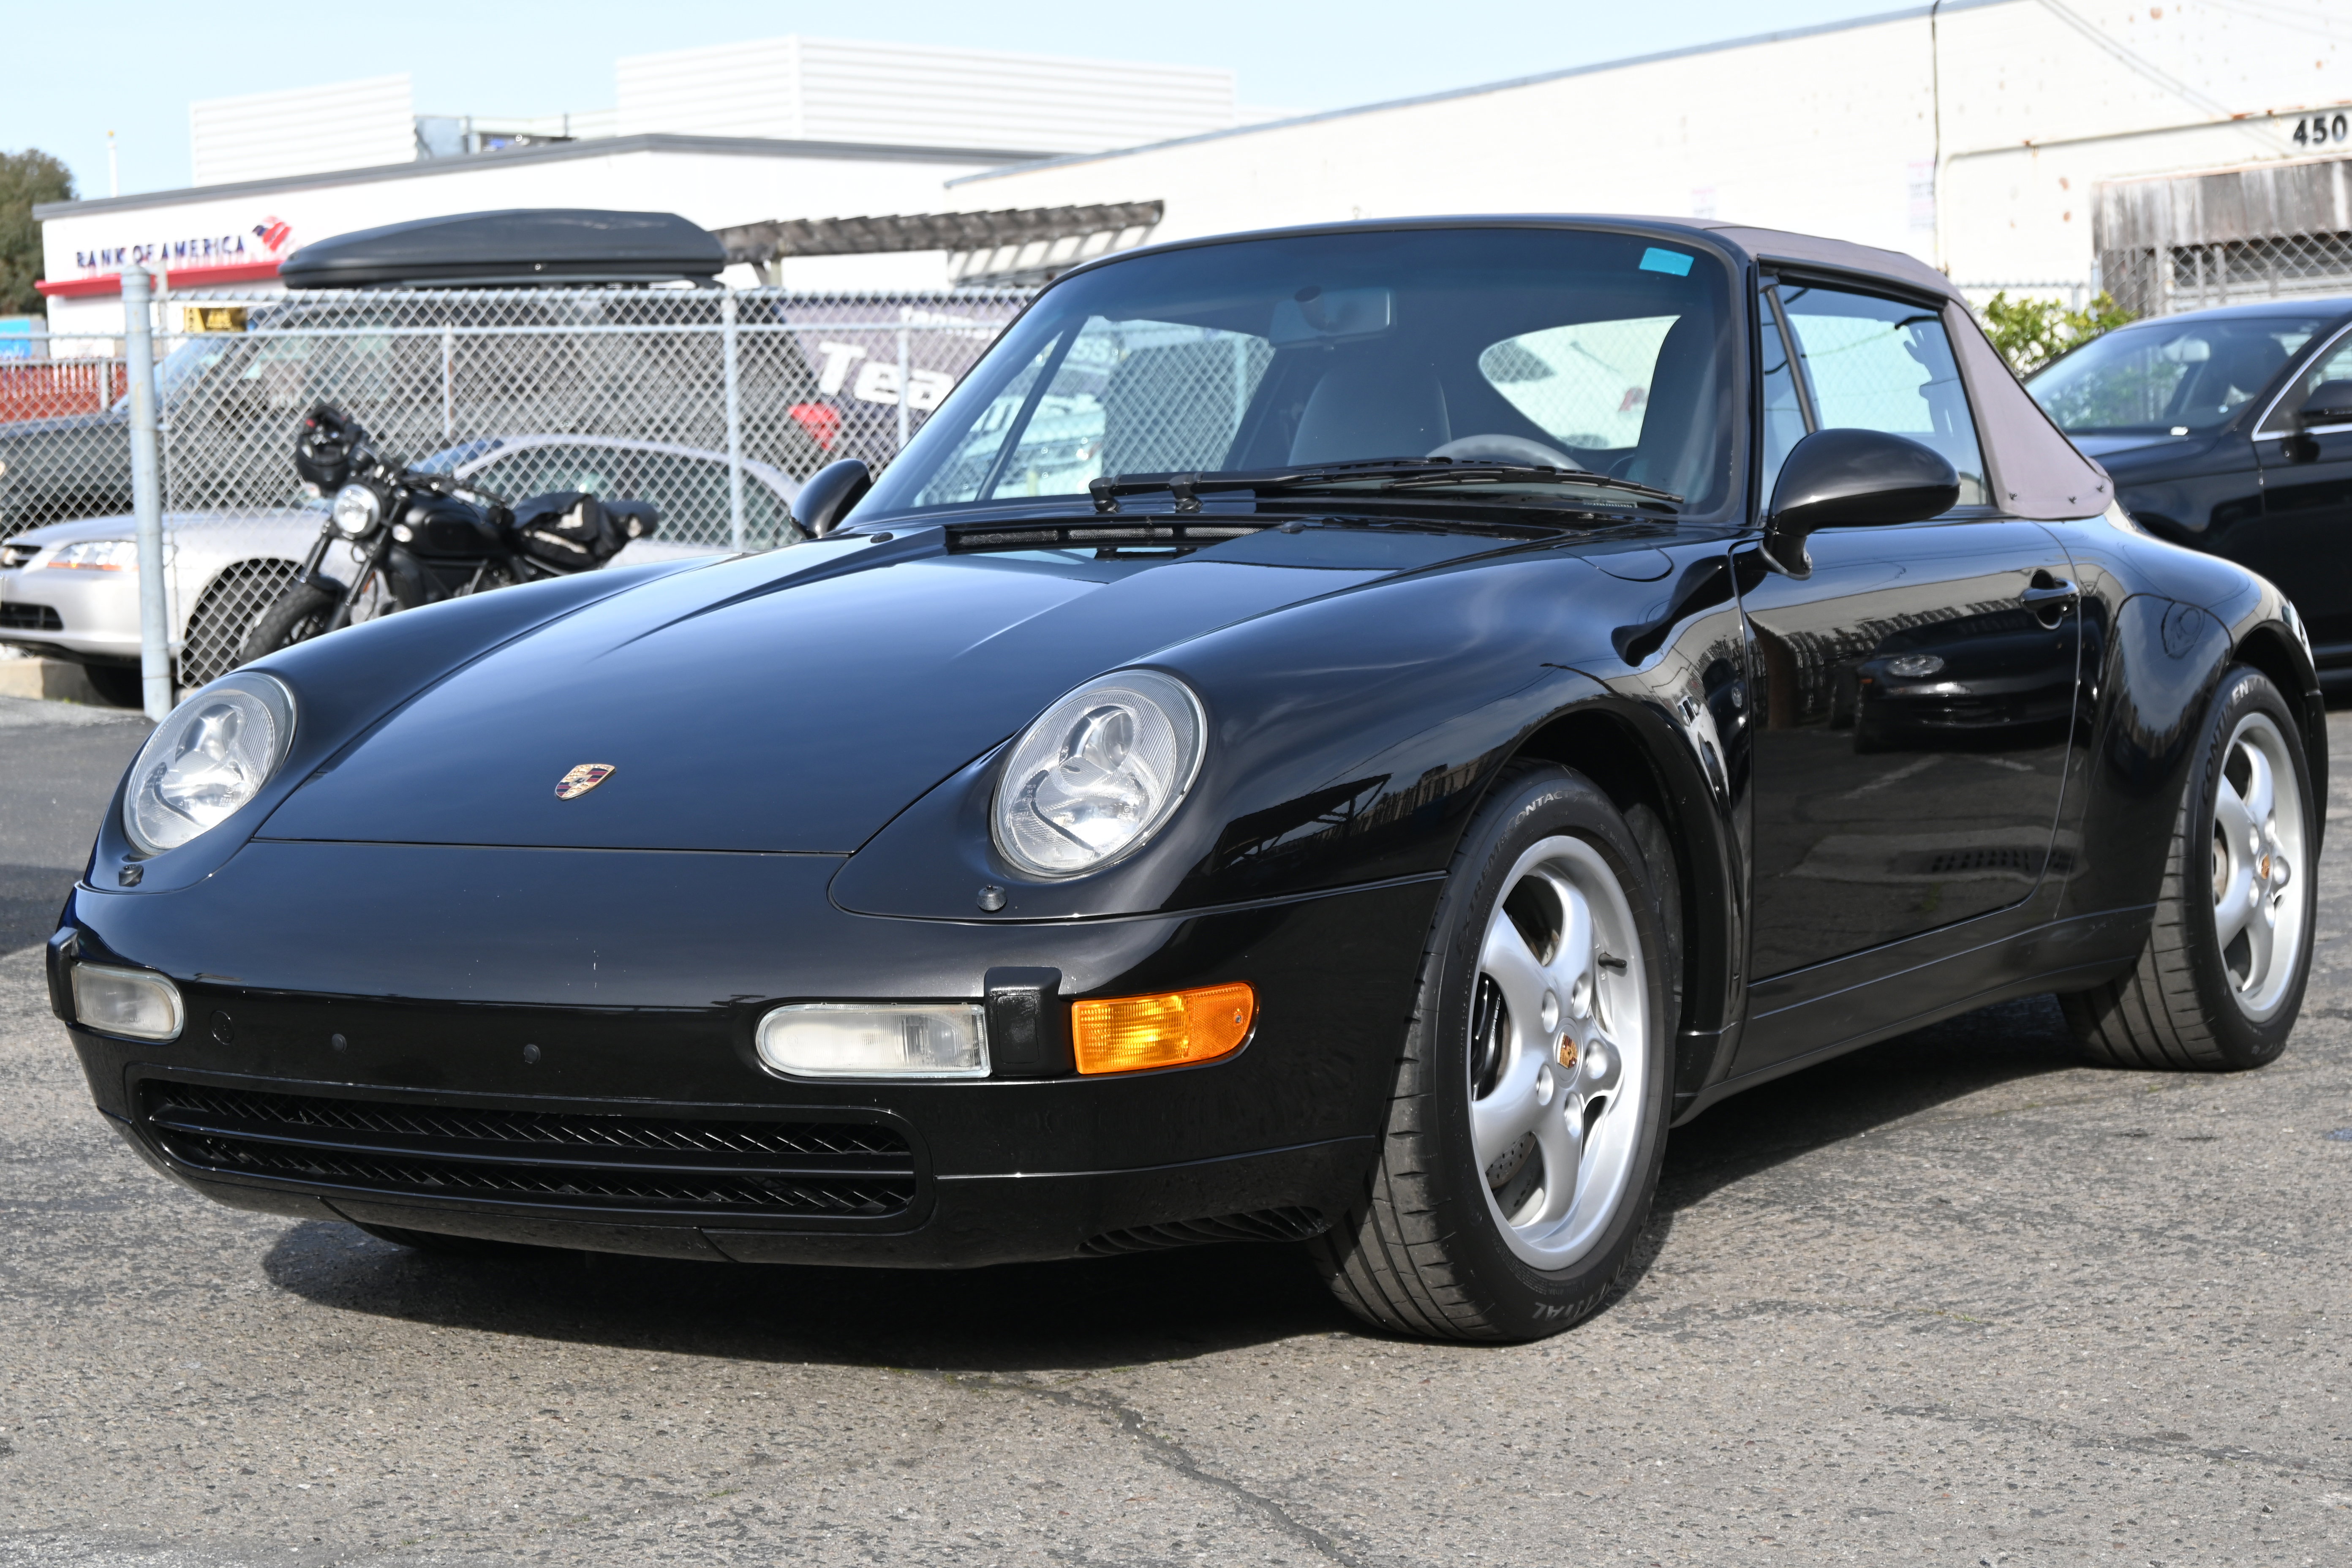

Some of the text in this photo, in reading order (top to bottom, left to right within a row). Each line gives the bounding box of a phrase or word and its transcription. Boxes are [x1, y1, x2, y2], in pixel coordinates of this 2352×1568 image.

[2293, 115, 2347, 146] 450
[76, 235, 244, 268] BANK OF AMERICA
